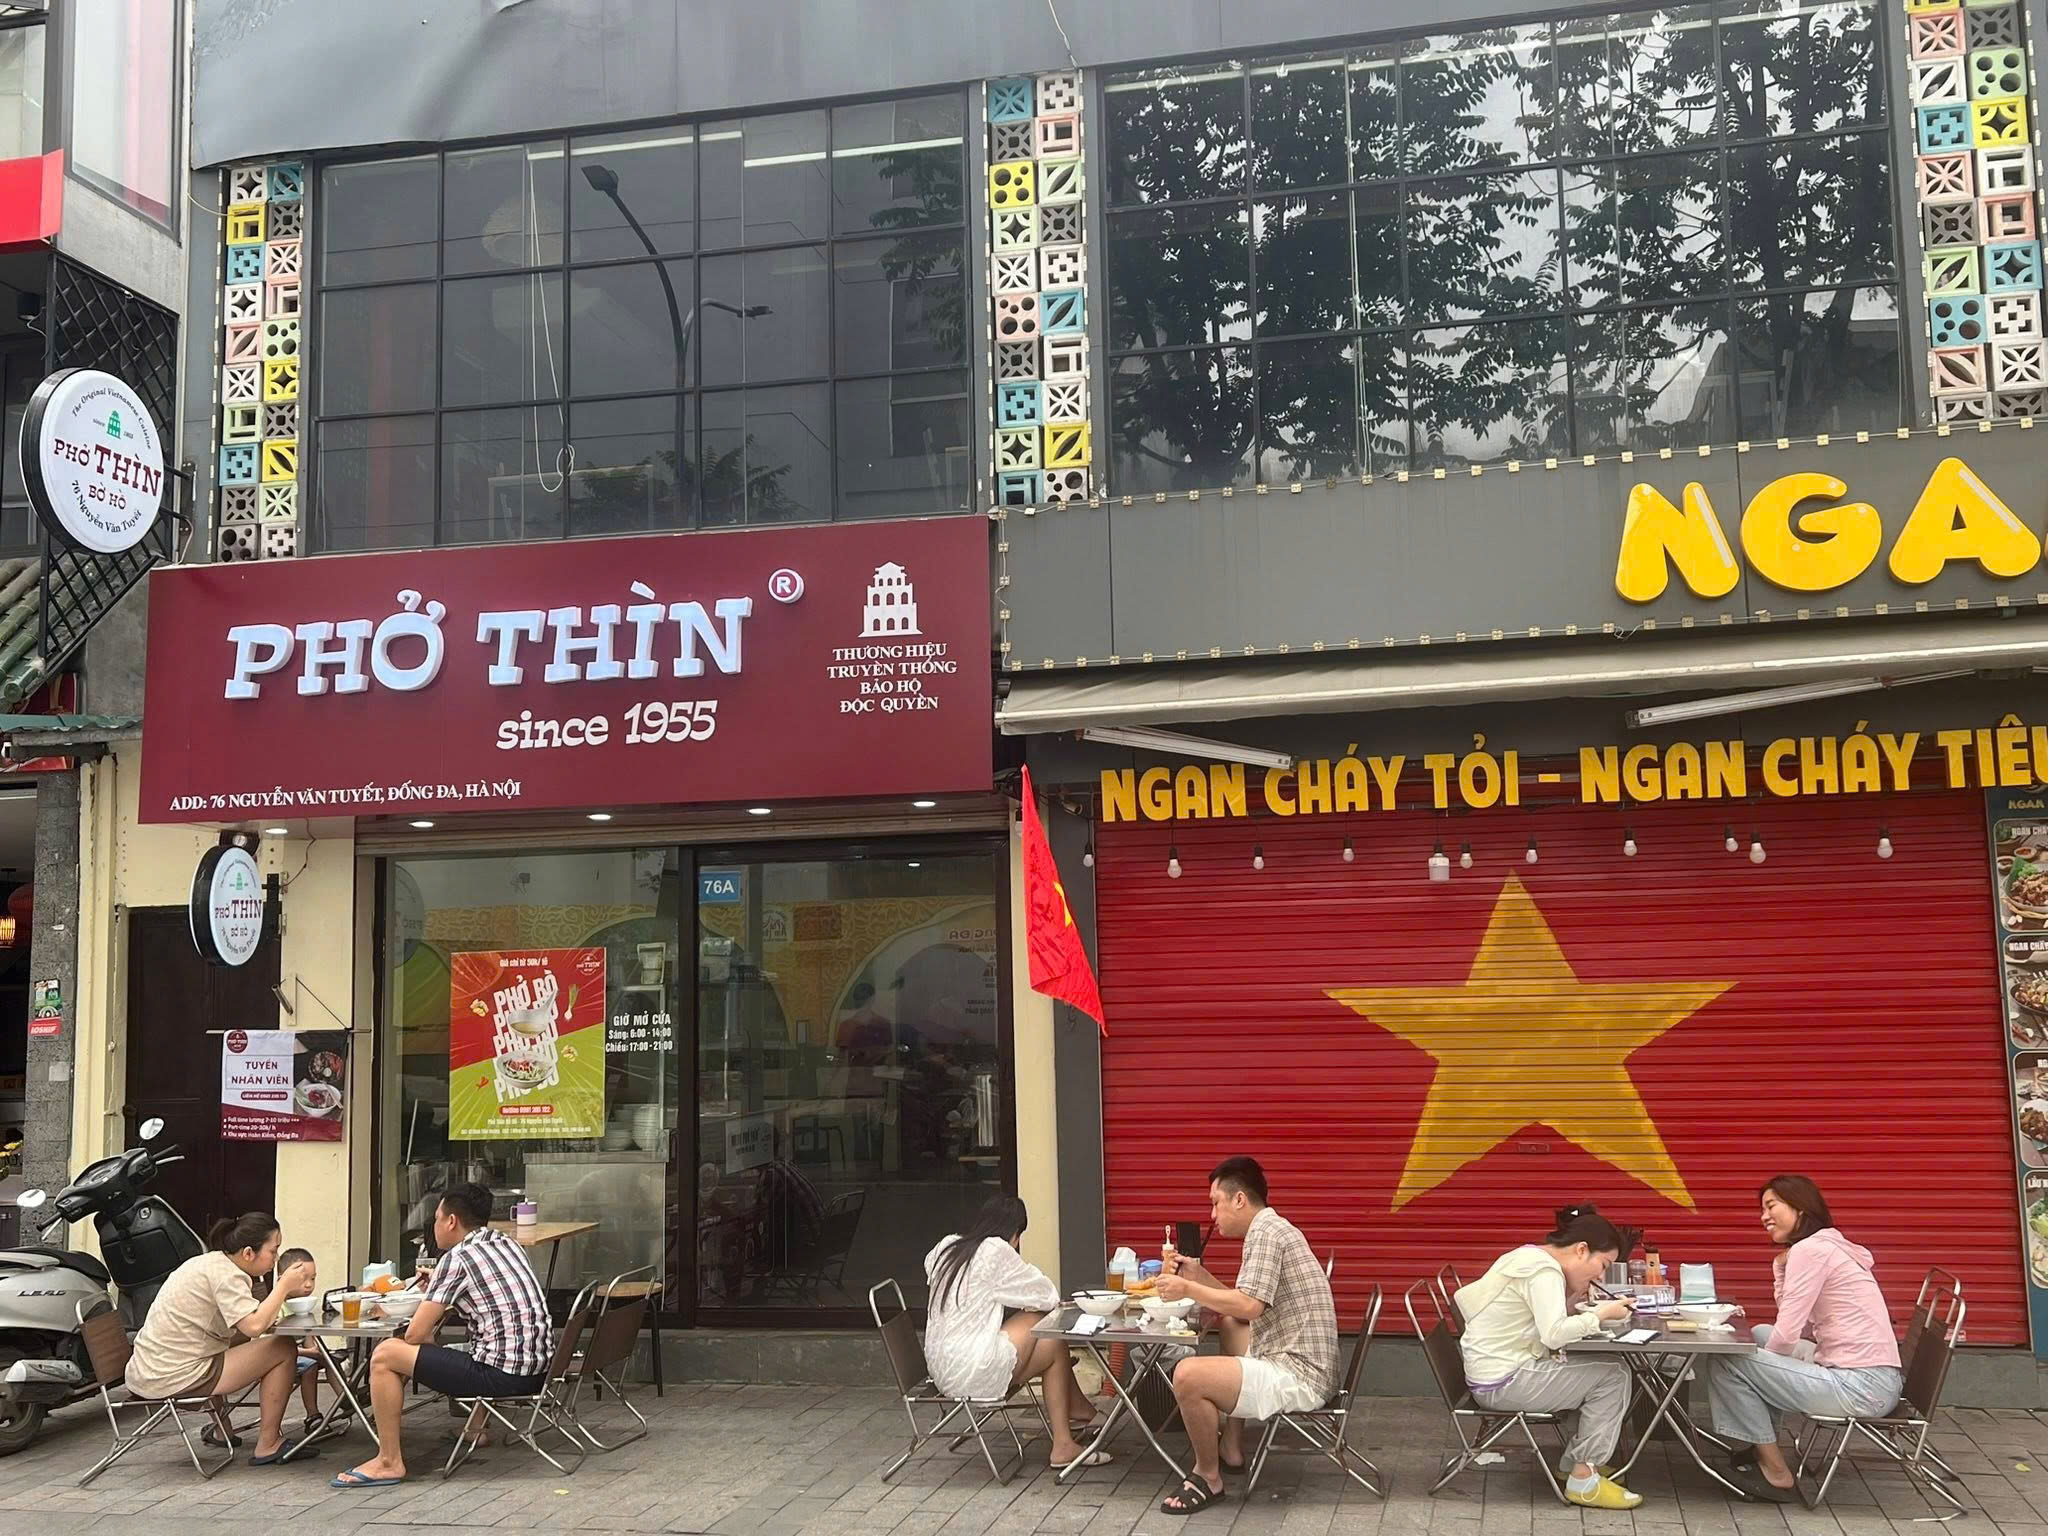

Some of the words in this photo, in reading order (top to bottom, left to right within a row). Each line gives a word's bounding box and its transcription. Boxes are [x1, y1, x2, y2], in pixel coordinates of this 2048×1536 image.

[54, 438, 91, 467] PHỞ
[94, 443, 162, 497] THÌN
[88, 481, 107, 502] BỜ
[71, 480, 81, 495] 76
[76, 494, 104, 529] Nguyễn
[105, 521, 121, 533] Văn
[1615, 456, 2048, 602] NGA
[224, 588, 446, 700] PHỞ
[476, 579, 752, 686] THÌN
[832, 644, 903, 661] THƯƠNG
[905, 641, 947, 658] HIỆU
[826, 660, 895, 679] TRUYỀN
[898, 656, 957, 675] THỐNG
[860, 677, 894, 695] BẢO
[896, 677, 922, 695] HỘ
[840, 698, 875, 715] ĐỘC
[880, 693, 939, 713] QUYỀN
[495, 707, 610, 750] since
[622, 700, 718, 744] 1955
[1100, 762, 1247, 823] NGAN
[1263, 743, 1406, 817] CHÁY
[1423, 733, 1521, 809] TỎI
[1579, 740, 1748, 804] NGAN
[1762, 720, 1921, 798] CHÁY
[169, 795, 208, 811] ADD:
[210, 794, 226, 809] 76
[228, 786, 294, 808] NGUYỄN
[296, 788, 328, 805] VĂN
[328, 781, 385, 804] TUYẾT,
[387, 779, 433, 801] ĐỐNG
[436, 783, 463, 800] ĐA,
[465, 779, 490, 798] HÀ
[492, 778, 522, 800] NỘI
[704, 879, 735, 895] 76A
[231, 894, 262, 919] THÌN
[493, 974, 531, 1013] PHỞ
[532, 969, 558, 1002] BÒ
[613, 1012, 630, 1026] GIỜ
[633, 1010, 649, 1026] MỞ
[652, 1009, 671, 1025] CỬA
[608, 1029, 629, 1040] Sáng:
[630, 1028, 646, 1039] 6:00
[652, 1027, 672, 1038] 14:00
[629, 1042, 649, 1052] 17:00
[653, 1040, 673, 1051] 21:00
[245, 1058, 278, 1070] TUYỂN
[231, 1074, 263, 1085] NHÂN
[266, 1073, 289, 1085] VIÊN
